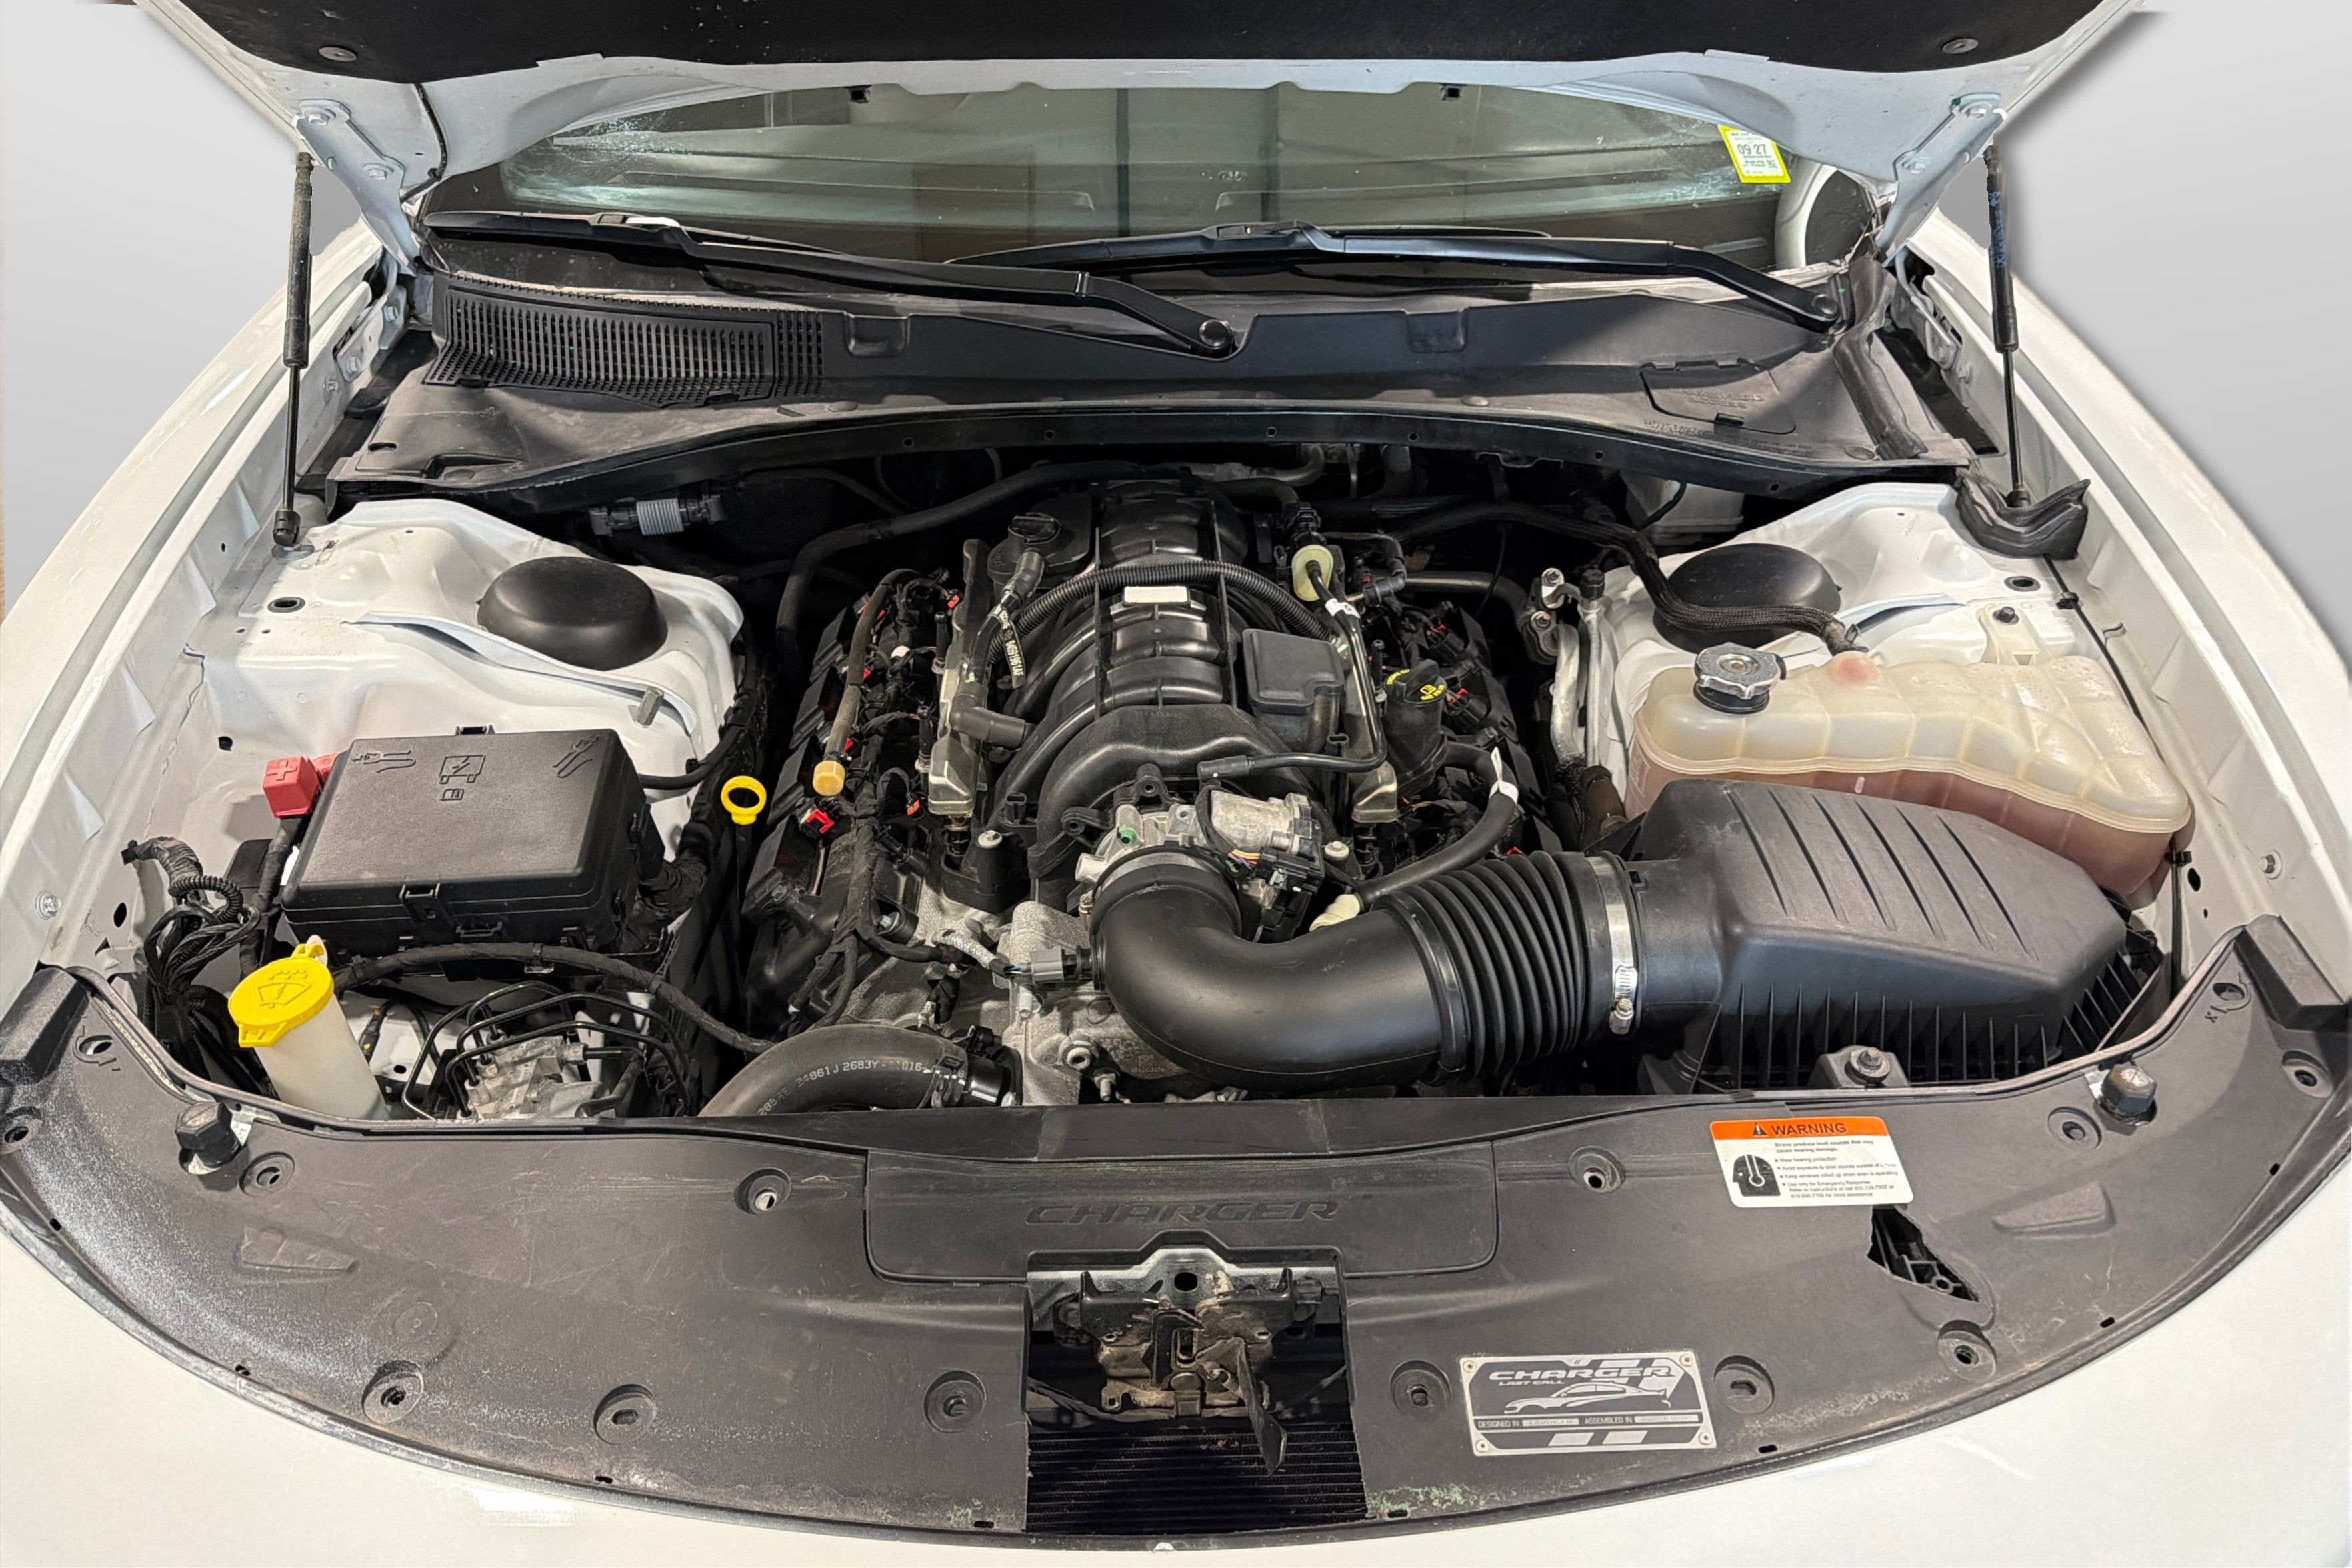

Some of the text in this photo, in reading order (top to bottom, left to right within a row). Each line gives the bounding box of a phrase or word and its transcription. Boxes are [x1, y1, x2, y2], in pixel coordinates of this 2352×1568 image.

[1771, 1123, 1846, 1135] WARNING
[1025, 1201, 1341, 1226] CHARGER
[1489, 1367, 1675, 1381] CHARGER
[1585, 1417, 1624, 1425] ASSEMBLED
